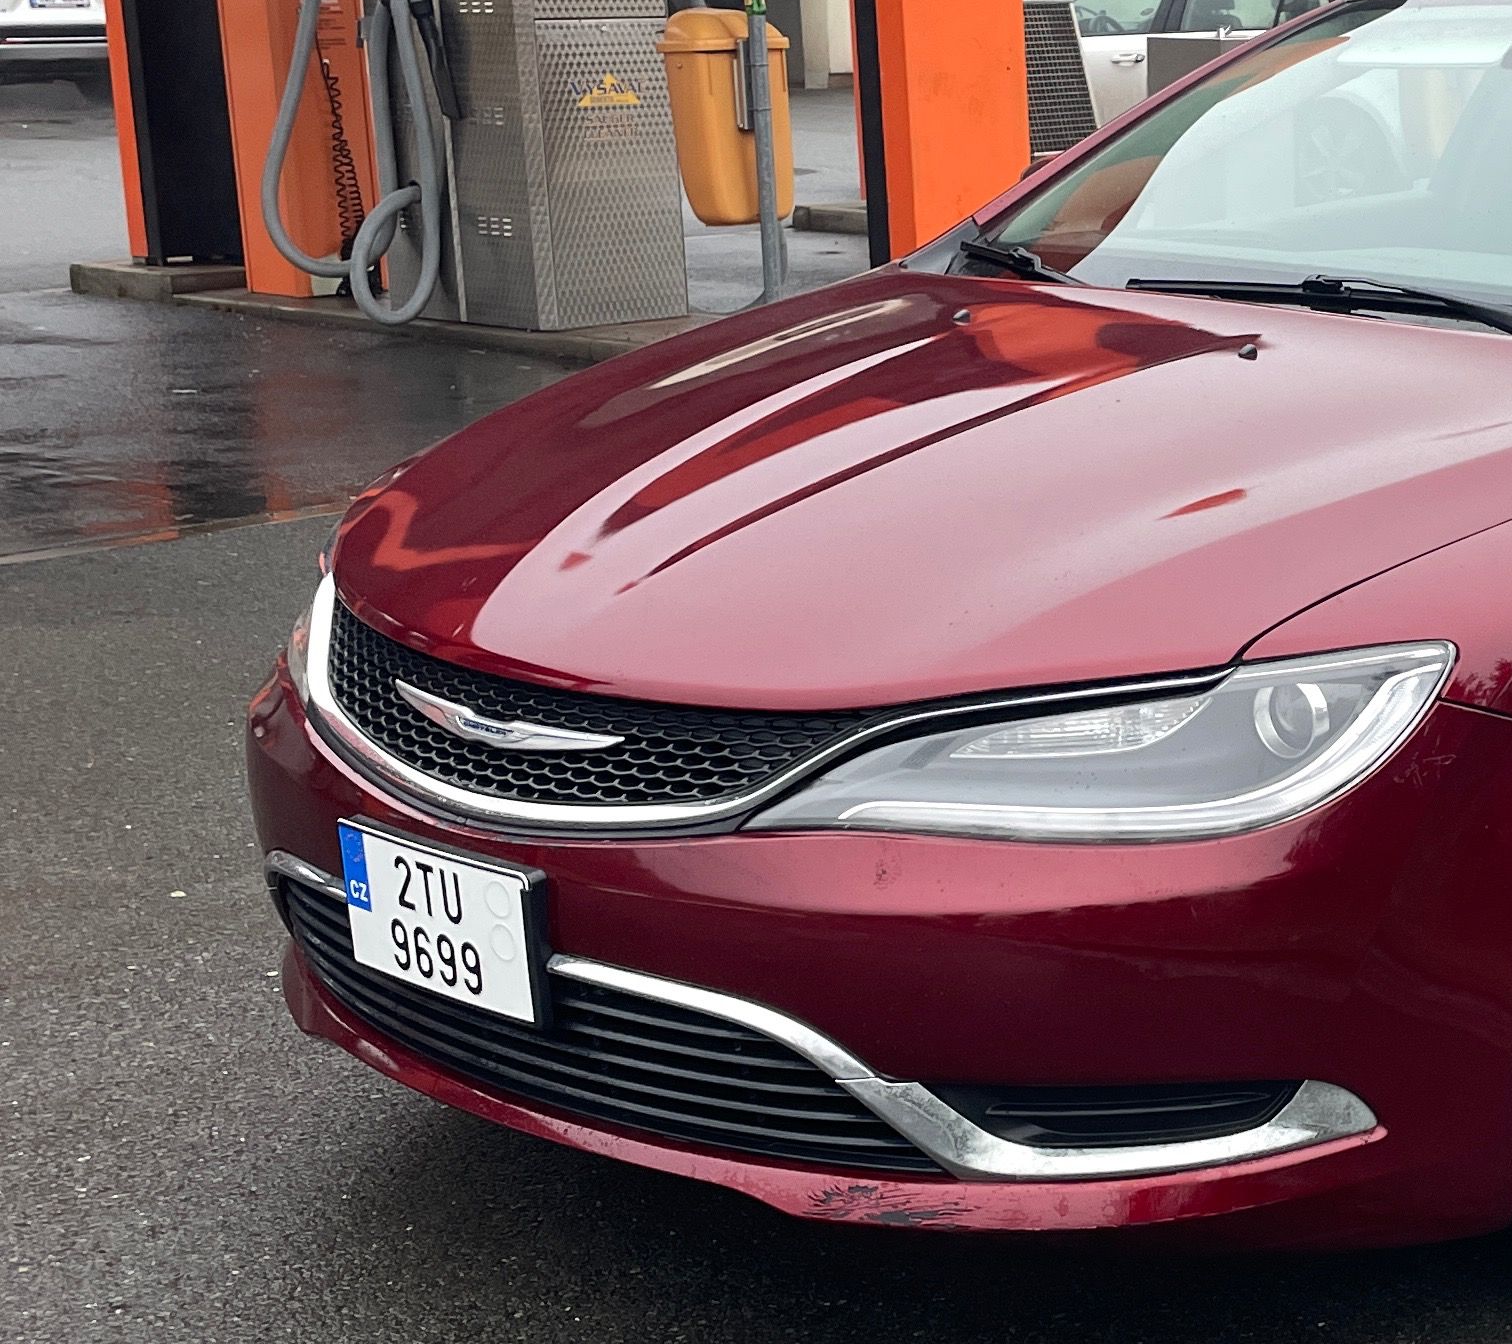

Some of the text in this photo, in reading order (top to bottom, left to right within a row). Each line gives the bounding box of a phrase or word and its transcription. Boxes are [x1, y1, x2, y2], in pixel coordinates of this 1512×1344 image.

[350, 879, 368, 902] CZ
[394, 856, 462, 924] 2TU
[391, 918, 482, 995] 9699
